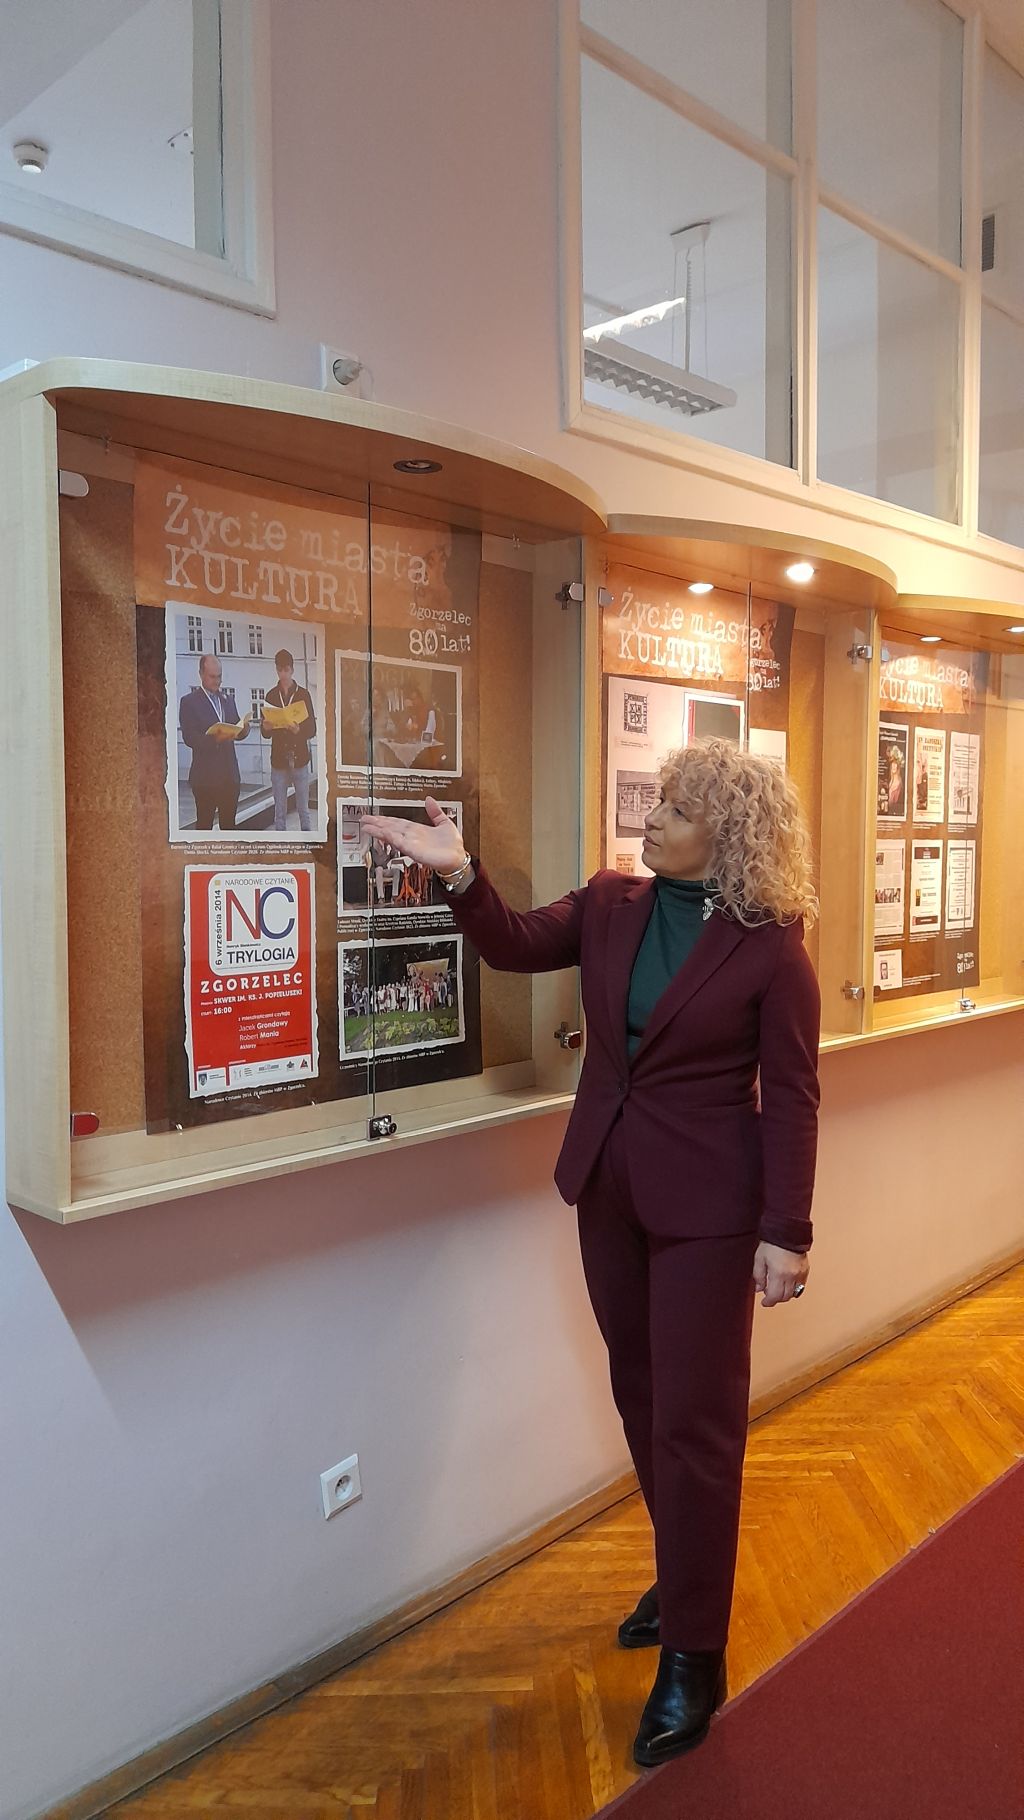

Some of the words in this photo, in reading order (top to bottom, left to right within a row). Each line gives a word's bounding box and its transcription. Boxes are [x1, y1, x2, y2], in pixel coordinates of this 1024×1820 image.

[164, 484, 287, 550] Życie
[300, 527, 430, 586] miasta
[165, 543, 363, 616] KULTURA
[410, 602, 471, 626] Zgorzelec
[618, 586, 685, 632] Życie
[690, 611, 762, 651] miasta
[409, 628, 439, 656] 80
[440, 634, 471, 652] lat!
[618, 629, 724, 675] KULTURA
[762, 675, 781, 689] lat!
[225, 878, 263, 887] NARODOWE
[264, 877, 295, 885] CZYTANIE
[226, 887, 295, 941] NC
[226, 947, 295, 964] TRYLOGIA
[201, 973, 303, 994] ZGORZELEC
[213, 997, 236, 1005] SKWER
[213, 1006, 233, 1015] 16:00
[239, 1023, 256, 1031] Jacek
[239, 1033, 259, 1041] Robert
[260, 1030, 280, 1038] Mania
